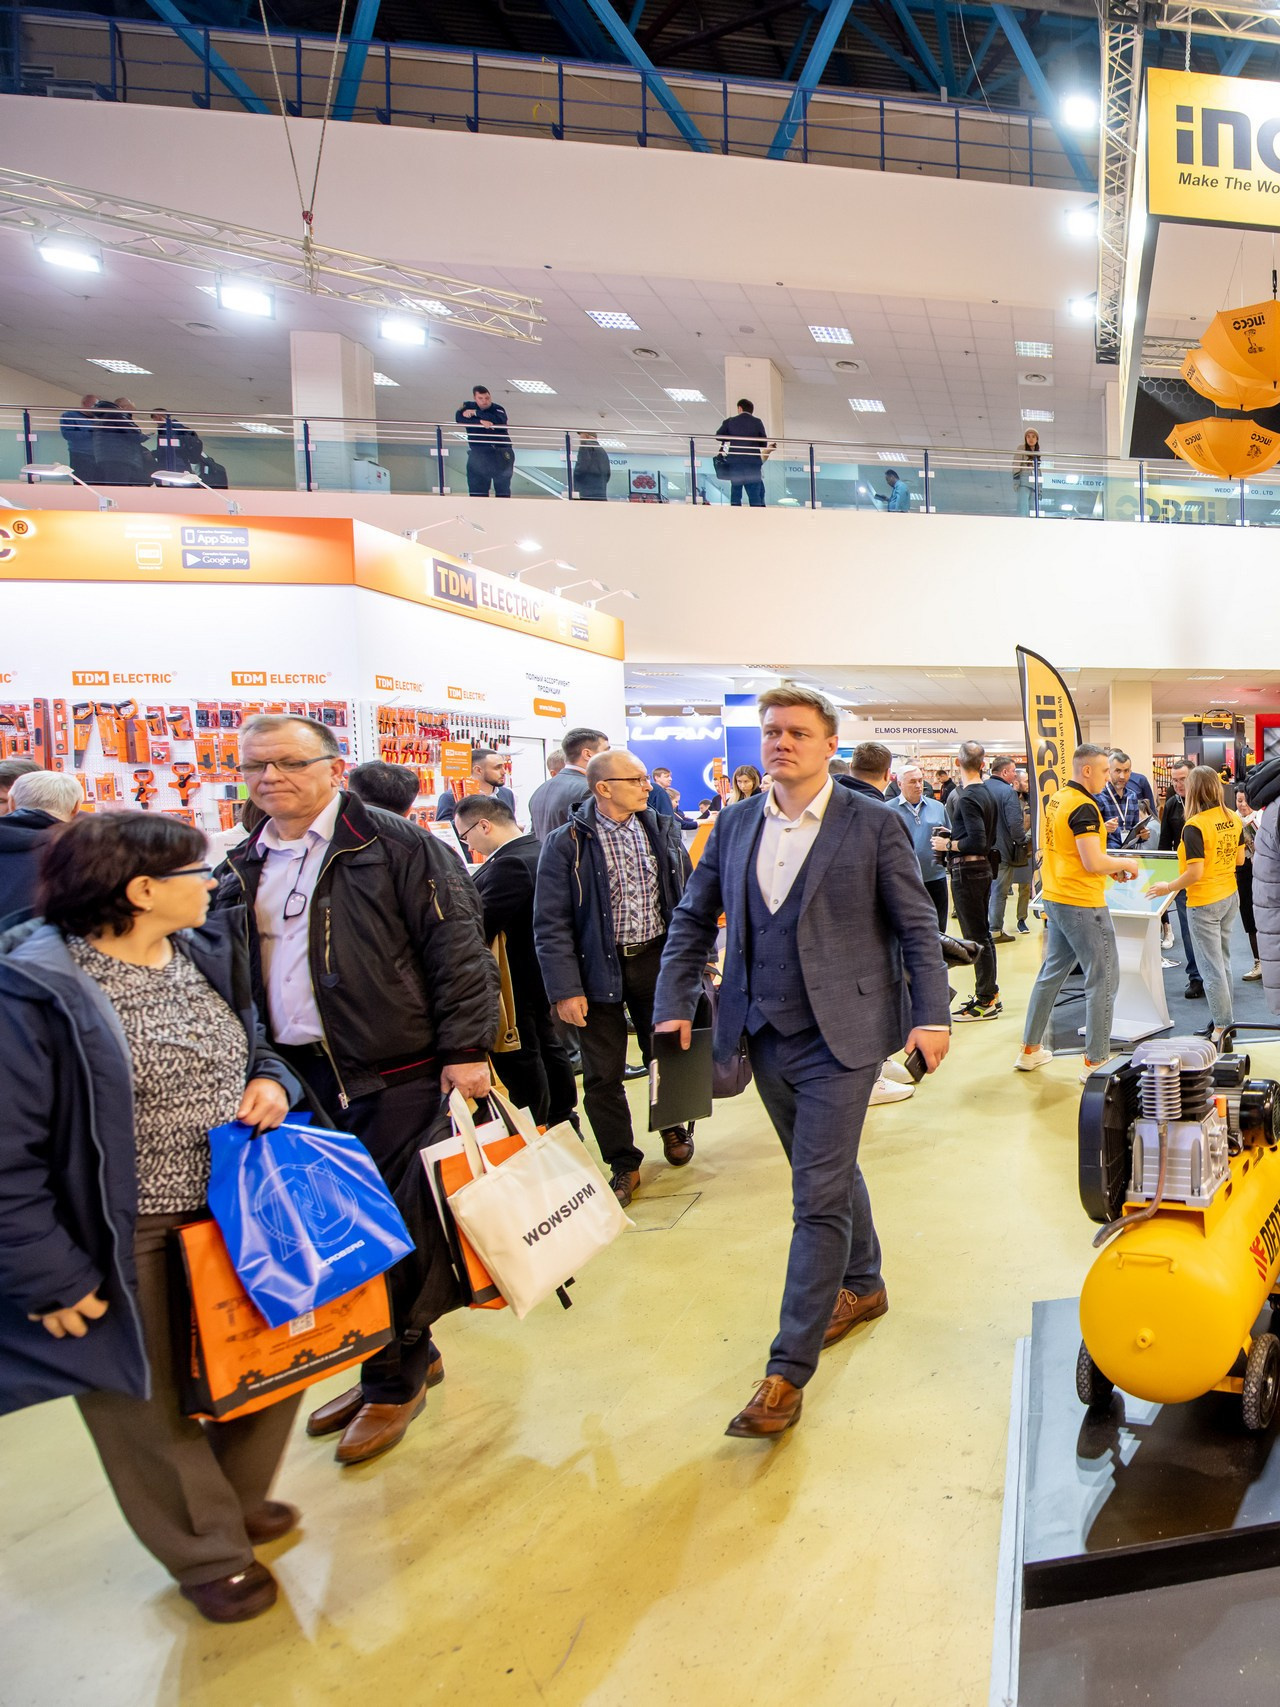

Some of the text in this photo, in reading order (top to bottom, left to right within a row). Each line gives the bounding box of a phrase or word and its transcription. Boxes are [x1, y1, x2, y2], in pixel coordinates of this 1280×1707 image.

[1178, 172, 1219, 190] Make
[1225, 176, 1252, 192] The
[197, 534, 246, 546] App Store
[202, 556, 248, 566] Google play
[436, 565, 540, 622] TDM ELECTRIC
[75, 672, 172, 685] TDM ELECTRIC
[234, 672, 327, 685] TDM ELECTRIC
[376, 676, 423, 693] TDM ELECTRIC
[448, 688, 486, 702] TDM ELECTRIC
[630, 726, 723, 742] LIFAN
[874, 727, 959, 735] ELMOS PROFESSIONAL
[522, 1182, 596, 1247] WOWSUPM
